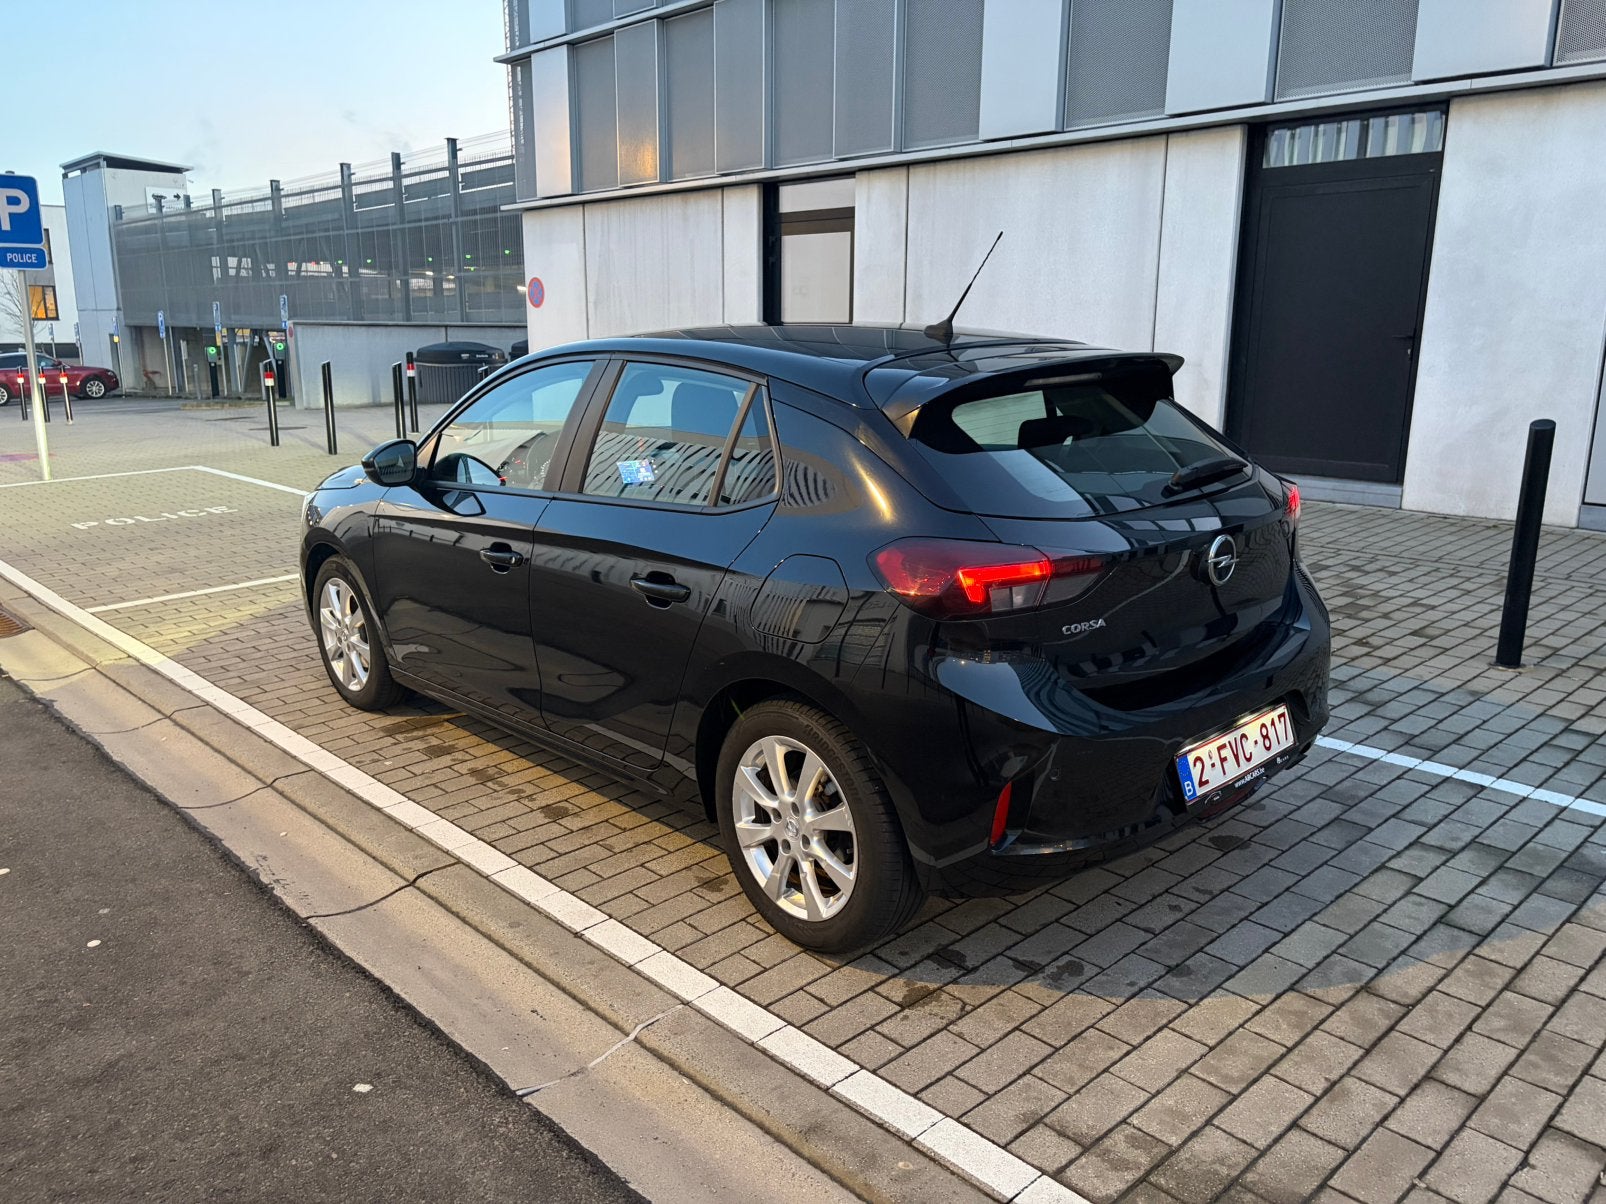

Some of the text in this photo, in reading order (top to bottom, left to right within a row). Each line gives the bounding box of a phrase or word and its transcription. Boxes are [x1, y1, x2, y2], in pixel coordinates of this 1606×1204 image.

[0, 188, 30, 231] P
[6, 252, 38, 263] POLICE
[70, 505, 239, 530] POLICE
[1061, 618, 1107, 635] CORSA
[1184, 780, 1194, 797] B
